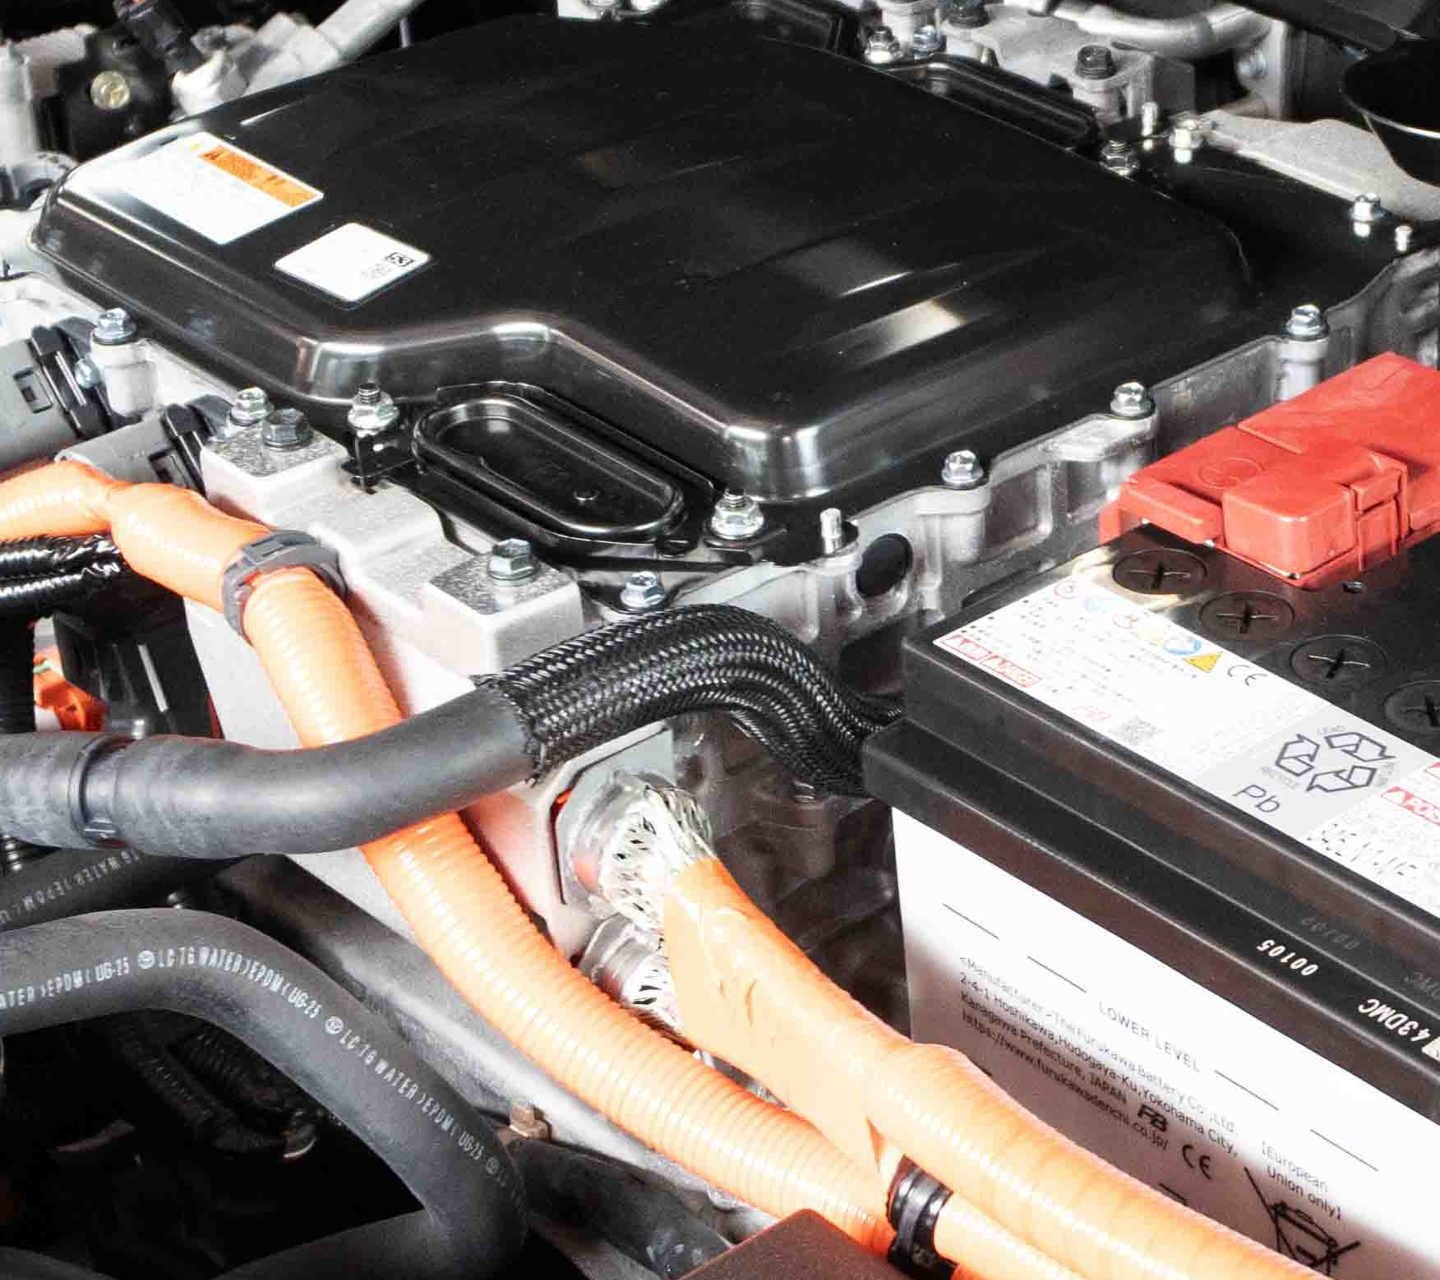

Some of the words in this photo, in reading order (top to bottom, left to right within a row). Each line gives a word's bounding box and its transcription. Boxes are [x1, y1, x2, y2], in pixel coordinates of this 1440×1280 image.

[1233, 784, 1282, 815] Pb
[198, 946, 243, 973] WATER
[1256, 938, 1321, 977] 00105
[1098, 1000, 1151, 1040] LOWER
[1155, 1034, 1201, 1073] LEVEL
[1357, 997, 1433, 1043] 43DMC
[374, 1058, 419, 1102] WATER
[1266, 1164, 1307, 1199] Union
